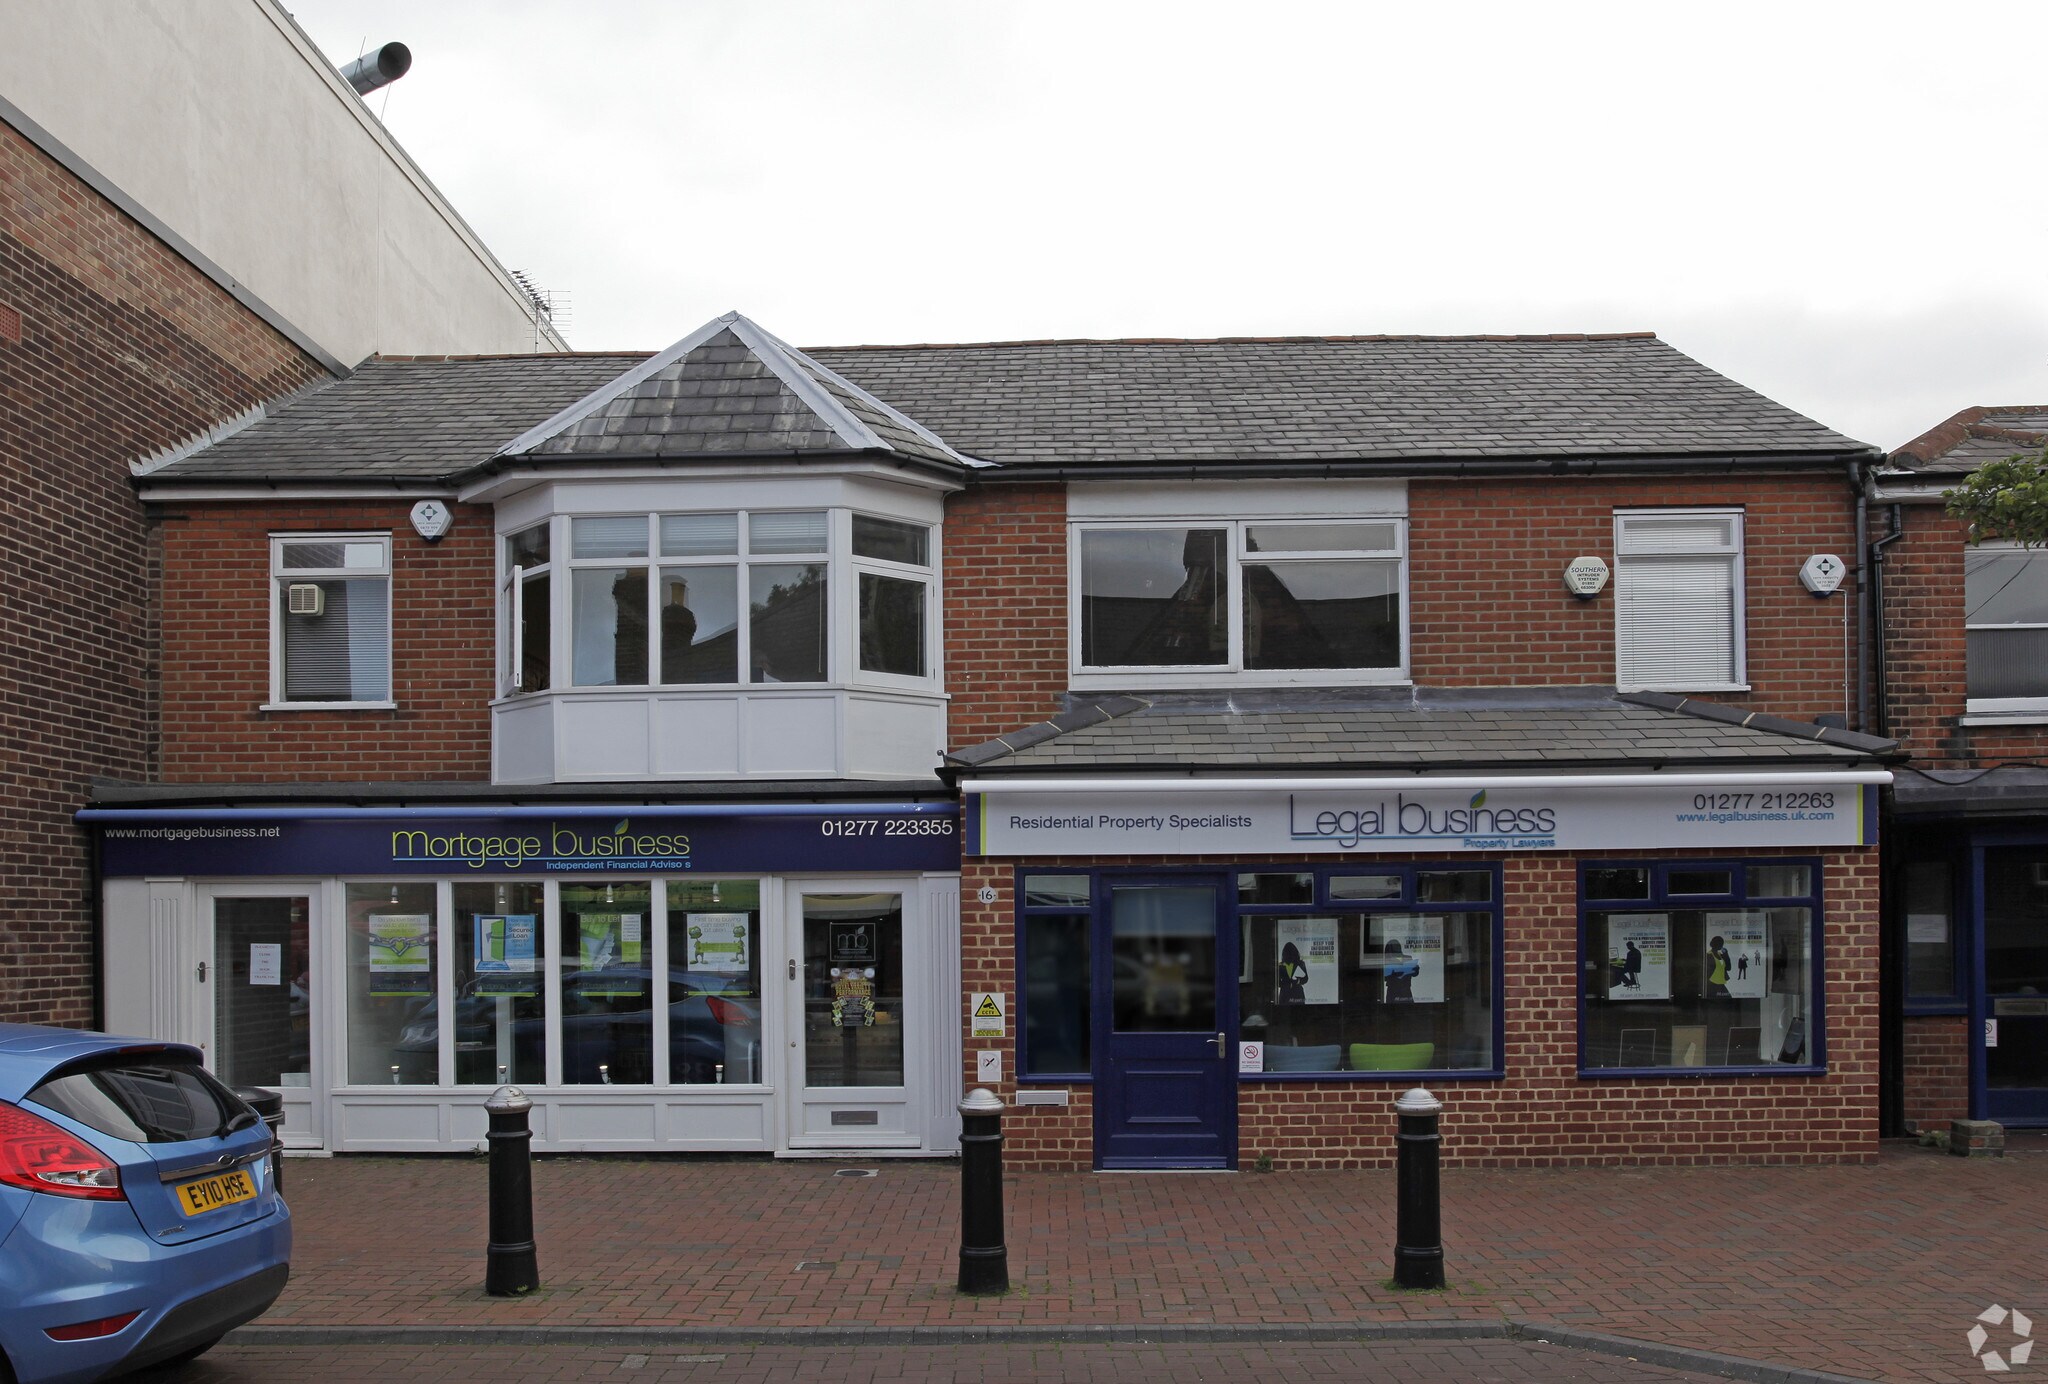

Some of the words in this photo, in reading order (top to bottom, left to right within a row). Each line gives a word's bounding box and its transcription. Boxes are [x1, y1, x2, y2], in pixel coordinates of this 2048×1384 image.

[1694, 793, 1754, 810] 01277
[1761, 792, 1835, 809] 212263
[1010, 814, 1094, 829] Residential
[1099, 814, 1164, 831] Property
[1169, 813, 1252, 830] Specialists
[1290, 794, 1386, 848] Legal
[1397, 789, 1556, 834] business
[1676, 810, 1835, 823] www.legalbusiness.uk.com
[105, 825, 280, 841] www.mortgagebusiness.net
[821, 819, 879, 836] 01277
[884, 819, 953, 836] 223355
[552, 820, 690, 857] business
[1463, 838, 1510, 850] Property
[1512, 838, 1556, 849] Lawyers
[546, 860, 605, 871] Independent
[606, 860, 649, 870] Financial
[981, 890, 993, 900] 16
[187, 1180, 223, 1209] EY10
[221, 1173, 249, 1199] HSE
